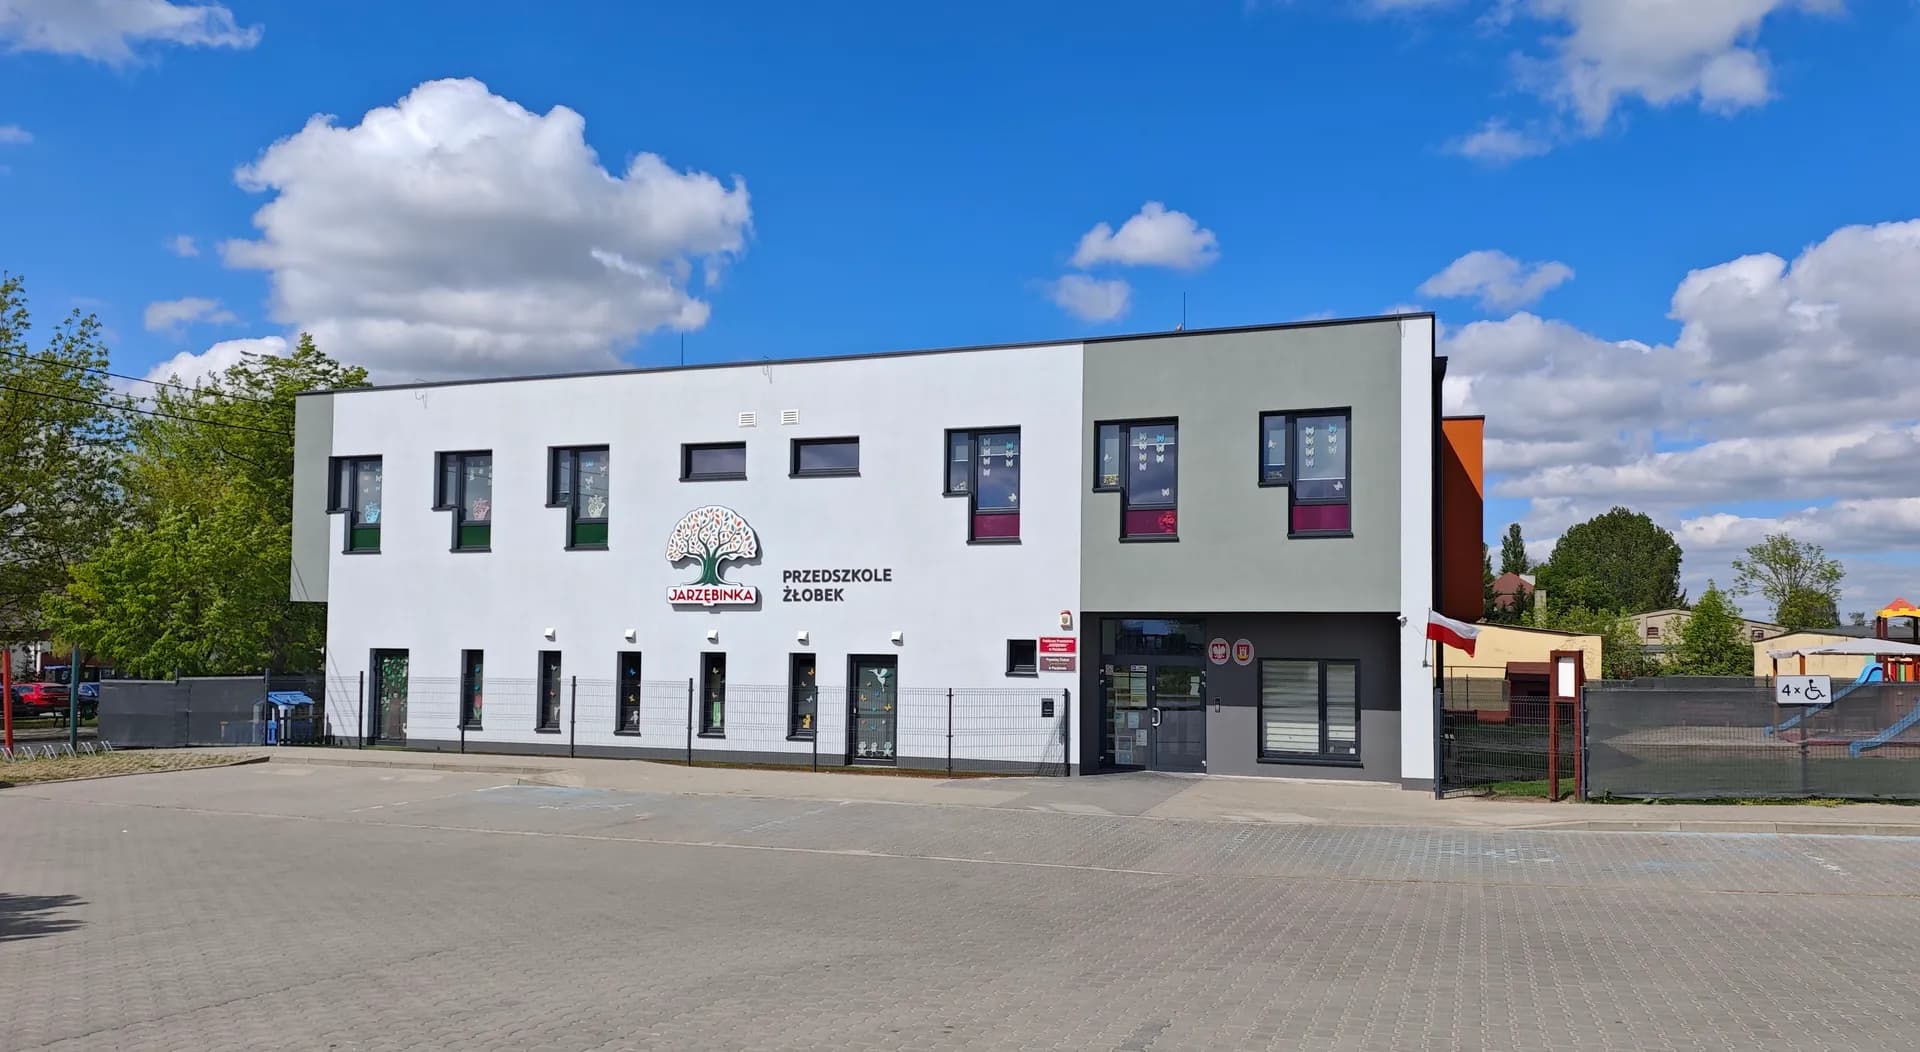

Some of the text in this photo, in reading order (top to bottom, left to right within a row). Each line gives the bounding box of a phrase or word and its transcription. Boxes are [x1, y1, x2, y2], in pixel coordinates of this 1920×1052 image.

[783, 568, 892, 583] PRZEDSZKOLE
[669, 588, 754, 604] JARZĘBINKA
[783, 585, 844, 602] ŻŁOBEK
[1782, 684, 1791, 696] 4
